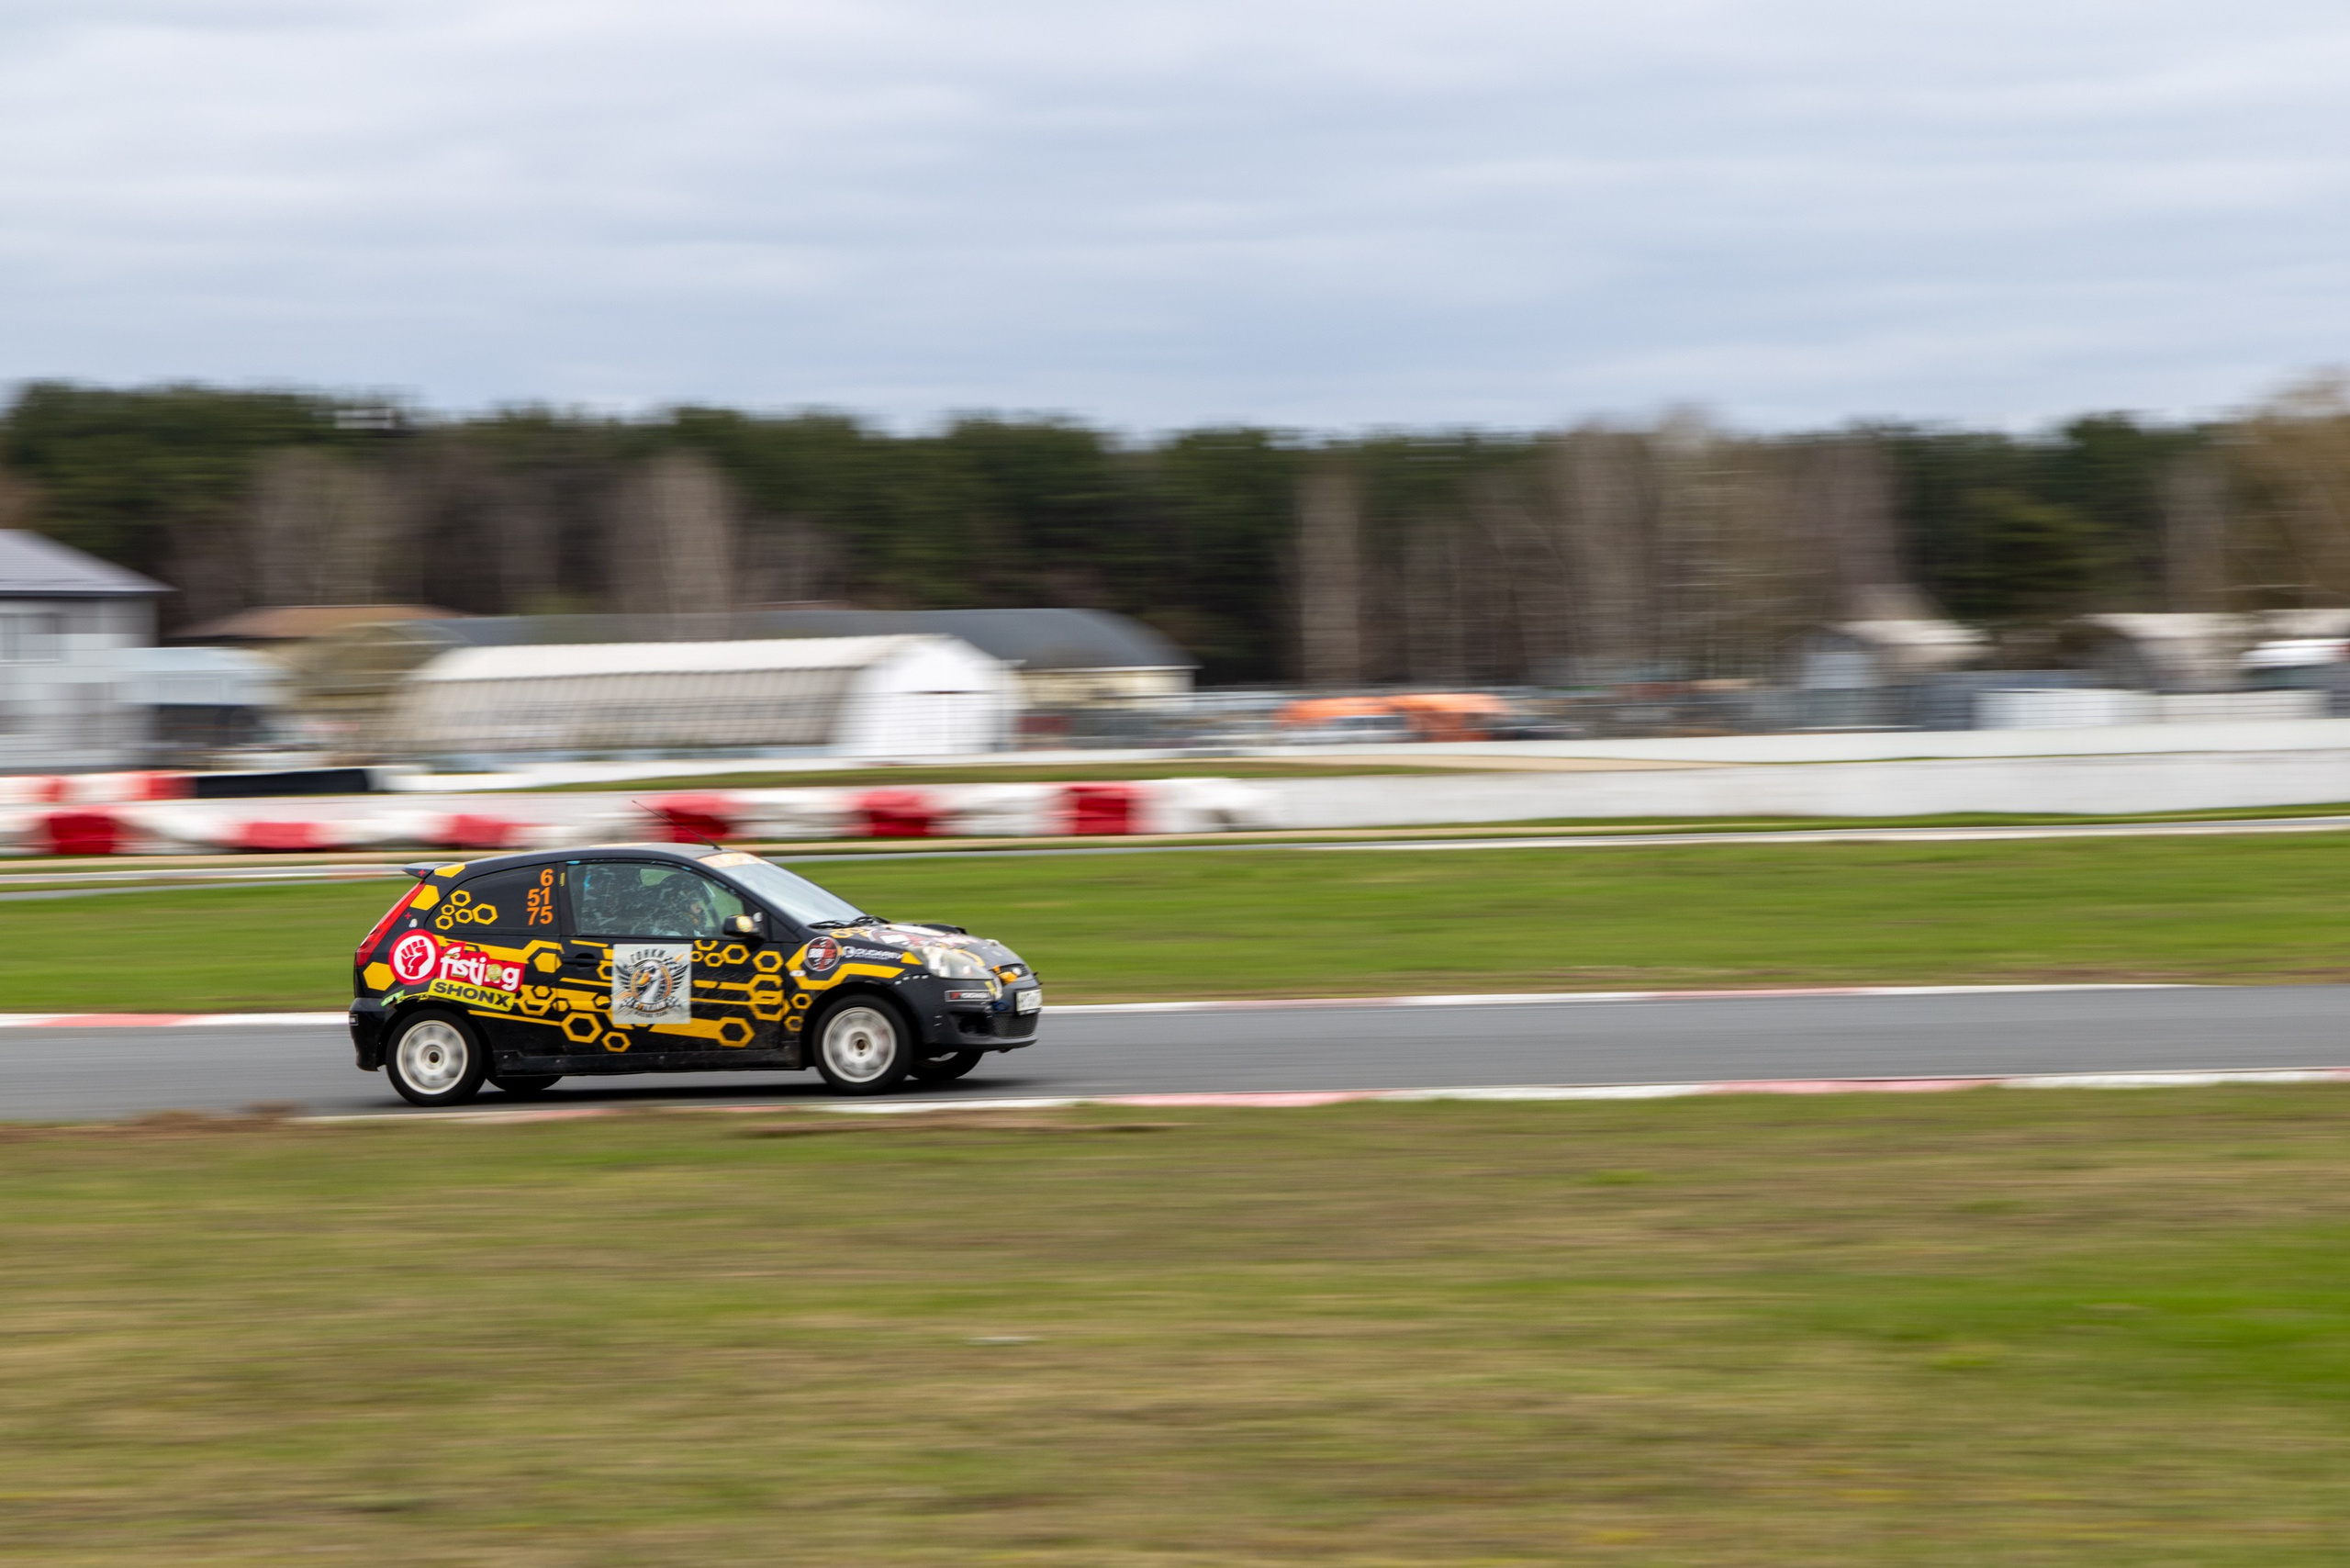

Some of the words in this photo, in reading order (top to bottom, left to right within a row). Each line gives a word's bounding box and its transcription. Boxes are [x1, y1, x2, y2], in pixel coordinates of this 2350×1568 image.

[540, 868, 554, 887] 6
[527, 887, 551, 907] 51
[526, 905, 553, 925] 75
[433, 981, 511, 1008] SHONX
